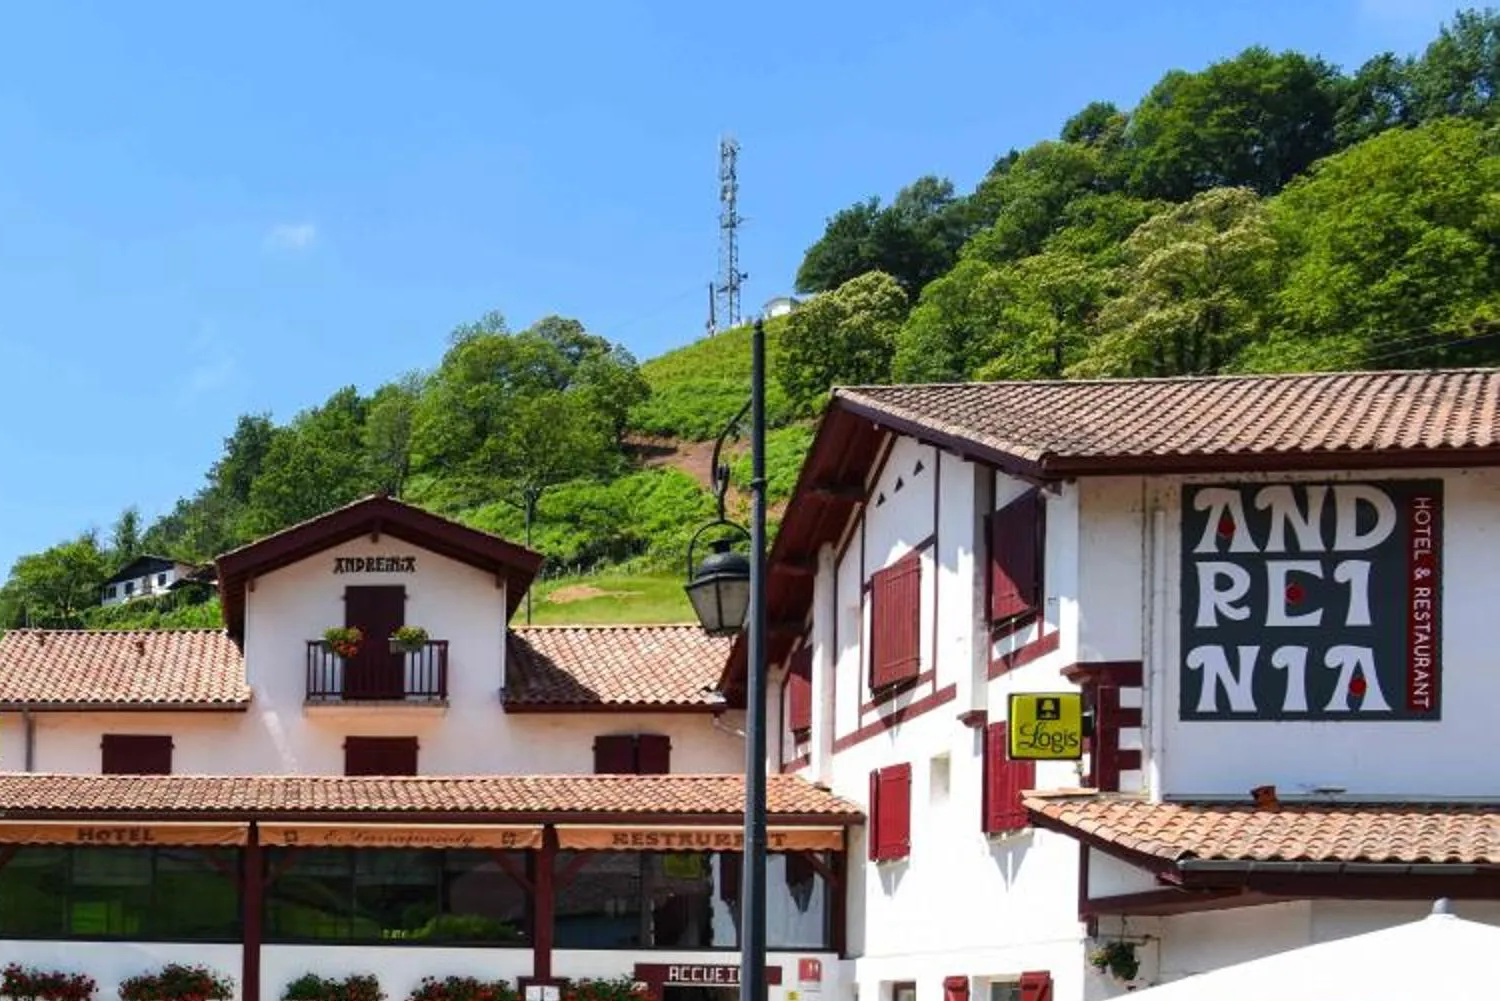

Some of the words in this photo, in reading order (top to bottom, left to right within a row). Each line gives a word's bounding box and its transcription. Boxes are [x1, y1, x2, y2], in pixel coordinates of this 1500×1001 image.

[1192, 484, 1397, 553] AND
[1414, 497, 1431, 560] HOTEL
[1194, 559, 1372, 627] REI
[1414, 567, 1431, 580] &
[1186, 644, 1392, 712] NIA
[1413, 587, 1432, 708] RESTAURANT
[1019, 720, 1079, 753] Logis
[77, 827, 155, 841] HOTEL
[612, 832, 787, 846] RESTAURT
